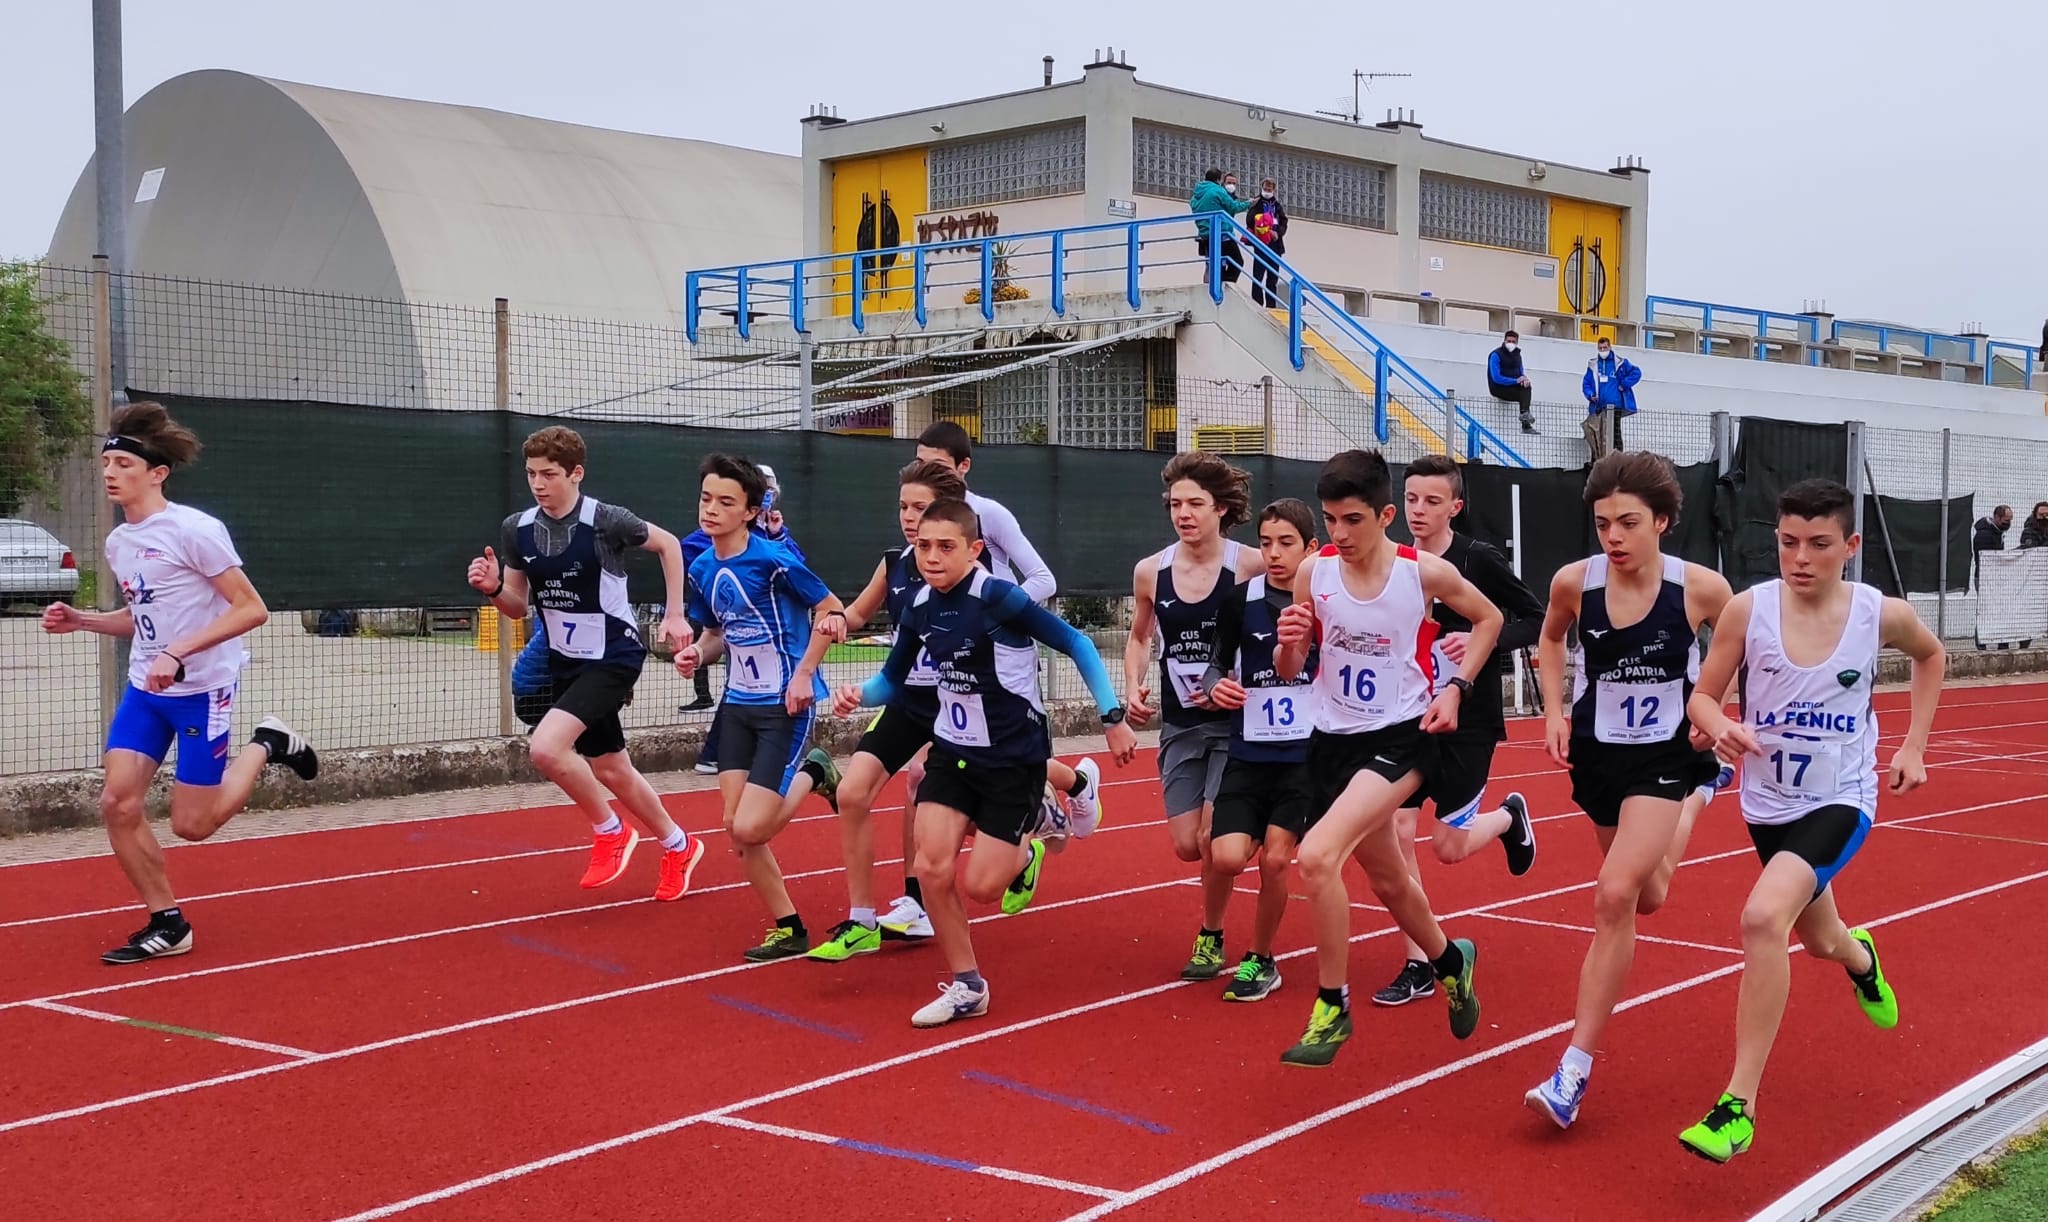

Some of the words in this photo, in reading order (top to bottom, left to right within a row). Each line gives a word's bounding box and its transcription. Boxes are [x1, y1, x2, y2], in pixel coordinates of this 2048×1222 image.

[545, 580, 562, 588] CUS
[550, 590, 581, 602] PATRIA
[134, 613, 156, 641] 19
[562, 621, 577, 646] 7
[1180, 630, 1200, 640] CUS
[1185, 641, 1211, 653] PATRI
[1642, 643, 1665, 655] pwc
[1617, 656, 1641, 668] CUS
[946, 670, 979, 684] PATRIA
[1253, 669, 1274, 682] PRO
[1599, 668, 1622, 681] PRO
[1625, 665, 1667, 678] PATRIA
[1338, 664, 1377, 702] 16
[1262, 697, 1295, 727] 13
[1620, 696, 1660, 728] 12
[1787, 701, 1825, 710] ATLETICA
[1756, 710, 1776, 726] LA
[1784, 711, 1856, 733] FENICE
[1770, 749, 1812, 787] 17
